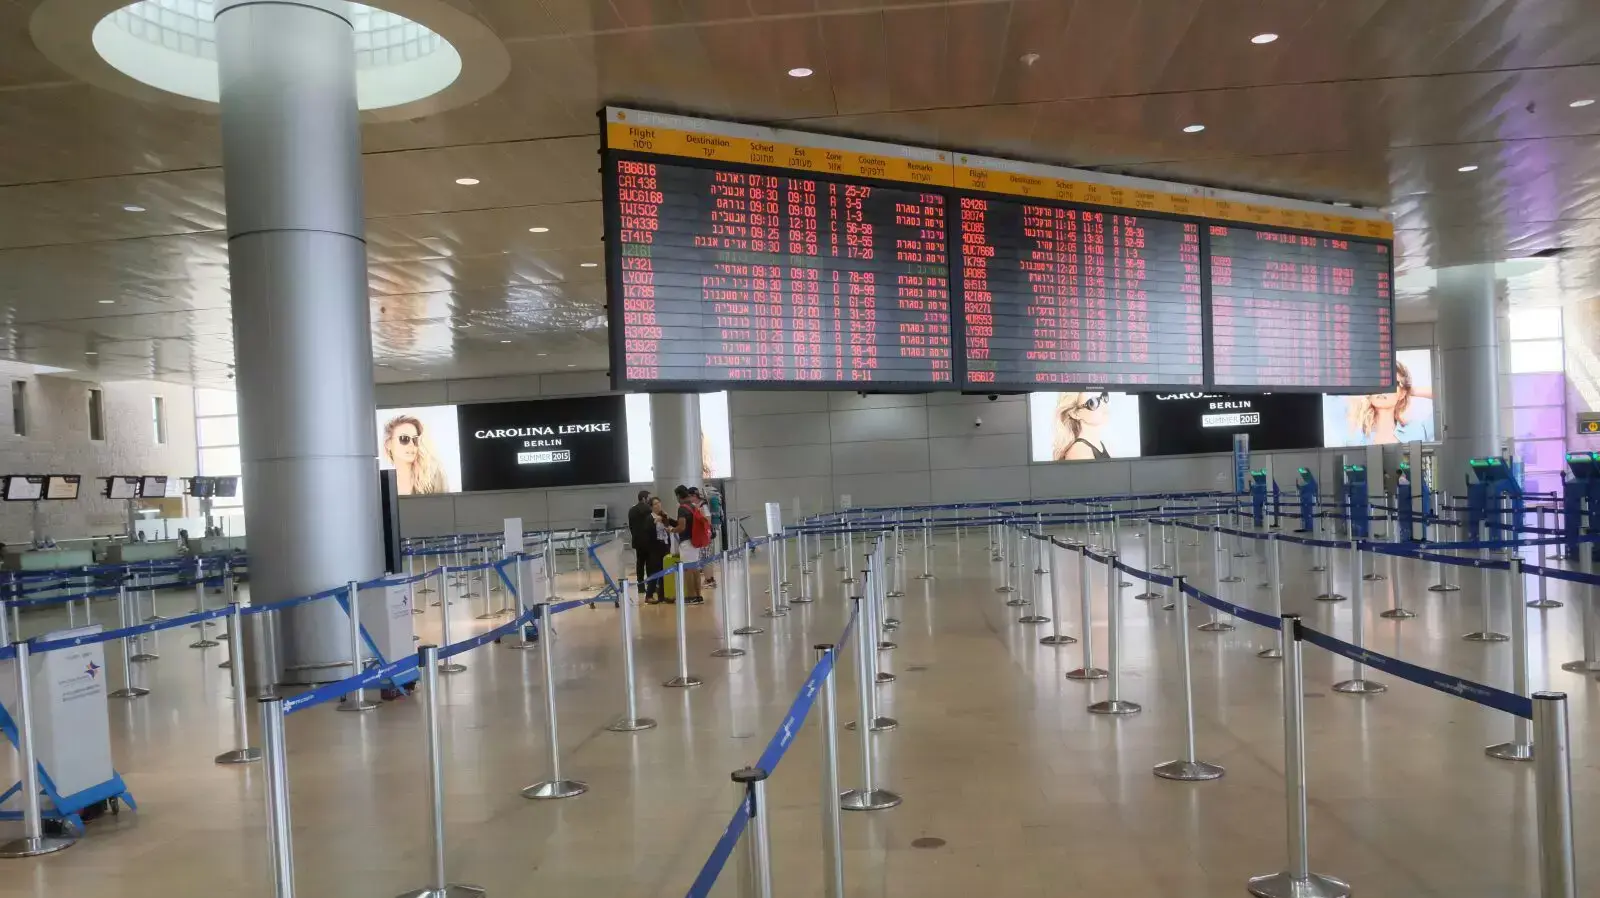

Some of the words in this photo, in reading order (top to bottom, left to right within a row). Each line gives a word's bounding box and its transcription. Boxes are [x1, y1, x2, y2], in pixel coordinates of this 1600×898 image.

[629, 127, 654, 140] Flight
[686, 134, 729, 147] Destination
[750, 142, 773, 152] Sched
[794, 148, 805, 156] Est
[826, 152, 842, 161] Zone
[617, 161, 655, 176] FB6616
[618, 175, 655, 189] CAI438
[749, 174, 777, 187] 07:10
[788, 178, 815, 191] 11:00
[830, 183, 836, 193] A
[845, 184, 870, 196] 25-27
[619, 189, 662, 204] BUC6168
[749, 188, 778, 200] 08:30
[788, 191, 815, 204] 09:10
[830, 195, 836, 206] A
[846, 197, 861, 208] 3-5
[619, 203, 656, 217] TWI502
[750, 201, 778, 213] 09:00
[788, 204, 816, 217] 09:00
[831, 208, 836, 218] A
[846, 209, 862, 220] 1-3
[750, 214, 778, 226] 09:10
[789, 217, 816, 229] 12:10
[831, 220, 837, 231] C
[1055, 219, 1075, 230] 11:15
[751, 227, 779, 239] 09:25
[847, 222, 872, 234] 56-58
[1083, 222, 1103, 233] 11:15
[620, 230, 652, 243] ET415
[789, 230, 817, 242] 09:25
[832, 233, 837, 243] B
[847, 234, 872, 246] 52-55
[751, 240, 779, 252] 09:30
[790, 243, 817, 254] 09:30
[832, 246, 838, 256] A
[1056, 241, 1076, 252] 12:05
[847, 247, 873, 258] 17-20
[1056, 252, 1076, 262] 12:10
[622, 258, 653, 270] LY321
[1057, 263, 1077, 273] 12:20
[752, 266, 780, 278] 09:30
[791, 268, 818, 280] 09:30
[622, 272, 653, 284] LY007
[752, 279, 781, 290] 09:30
[791, 281, 818, 292] 09:30
[753, 292, 781, 303] 09:50
[792, 294, 819, 305] 09:50
[754, 304, 782, 316] 10:00
[792, 306, 819, 317] 12:00
[849, 308, 874, 319] 31-33
[754, 317, 782, 328] 10:00
[1209, 401, 1251, 410] BERLIN
[1240, 415, 1258, 424] 2015
[475, 426, 555, 438] CAROLINA
[558, 423, 611, 434] LEMKE
[524, 439, 562, 448] BERLIN
[520, 454, 550, 462] SUMMER
[552, 452, 568, 460] 2015
